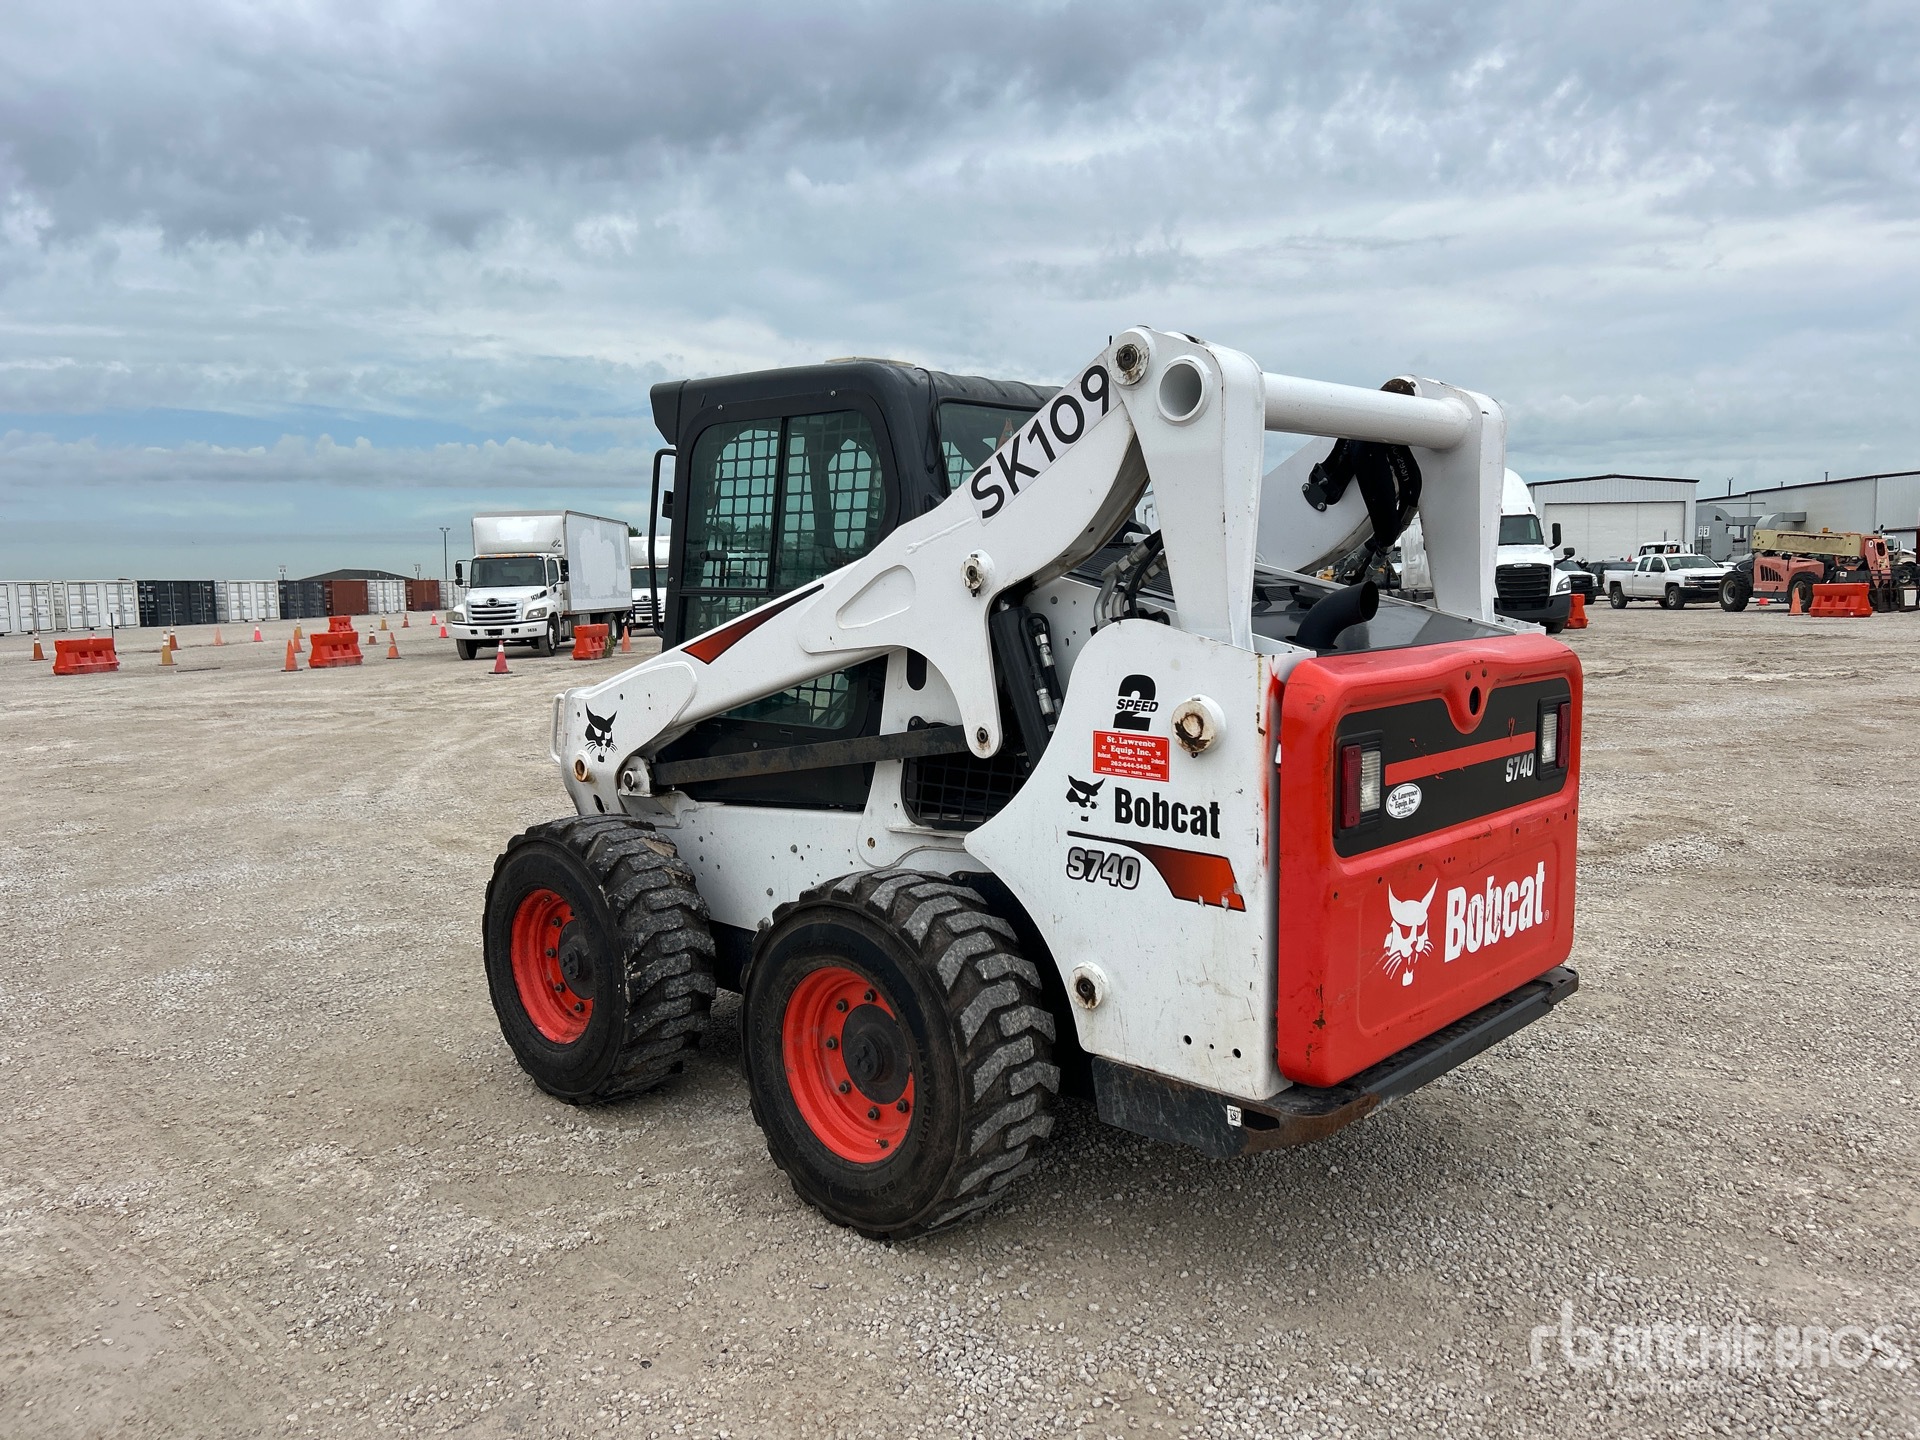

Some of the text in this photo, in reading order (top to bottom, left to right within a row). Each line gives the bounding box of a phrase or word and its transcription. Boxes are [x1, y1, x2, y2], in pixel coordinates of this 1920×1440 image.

[971, 365, 1110, 519] SK109
[1113, 674, 1156, 731] 2
[1116, 699, 1159, 713] SPEED
[1106, 735, 1156, 748] St. Lawrence
[1110, 745, 1152, 756] Equip. Inc.
[1505, 753, 1535, 783] S740
[1114, 786, 1221, 839] Bobcat
[1066, 846, 1141, 890] S740
[1444, 861, 1546, 963] Bobcat
